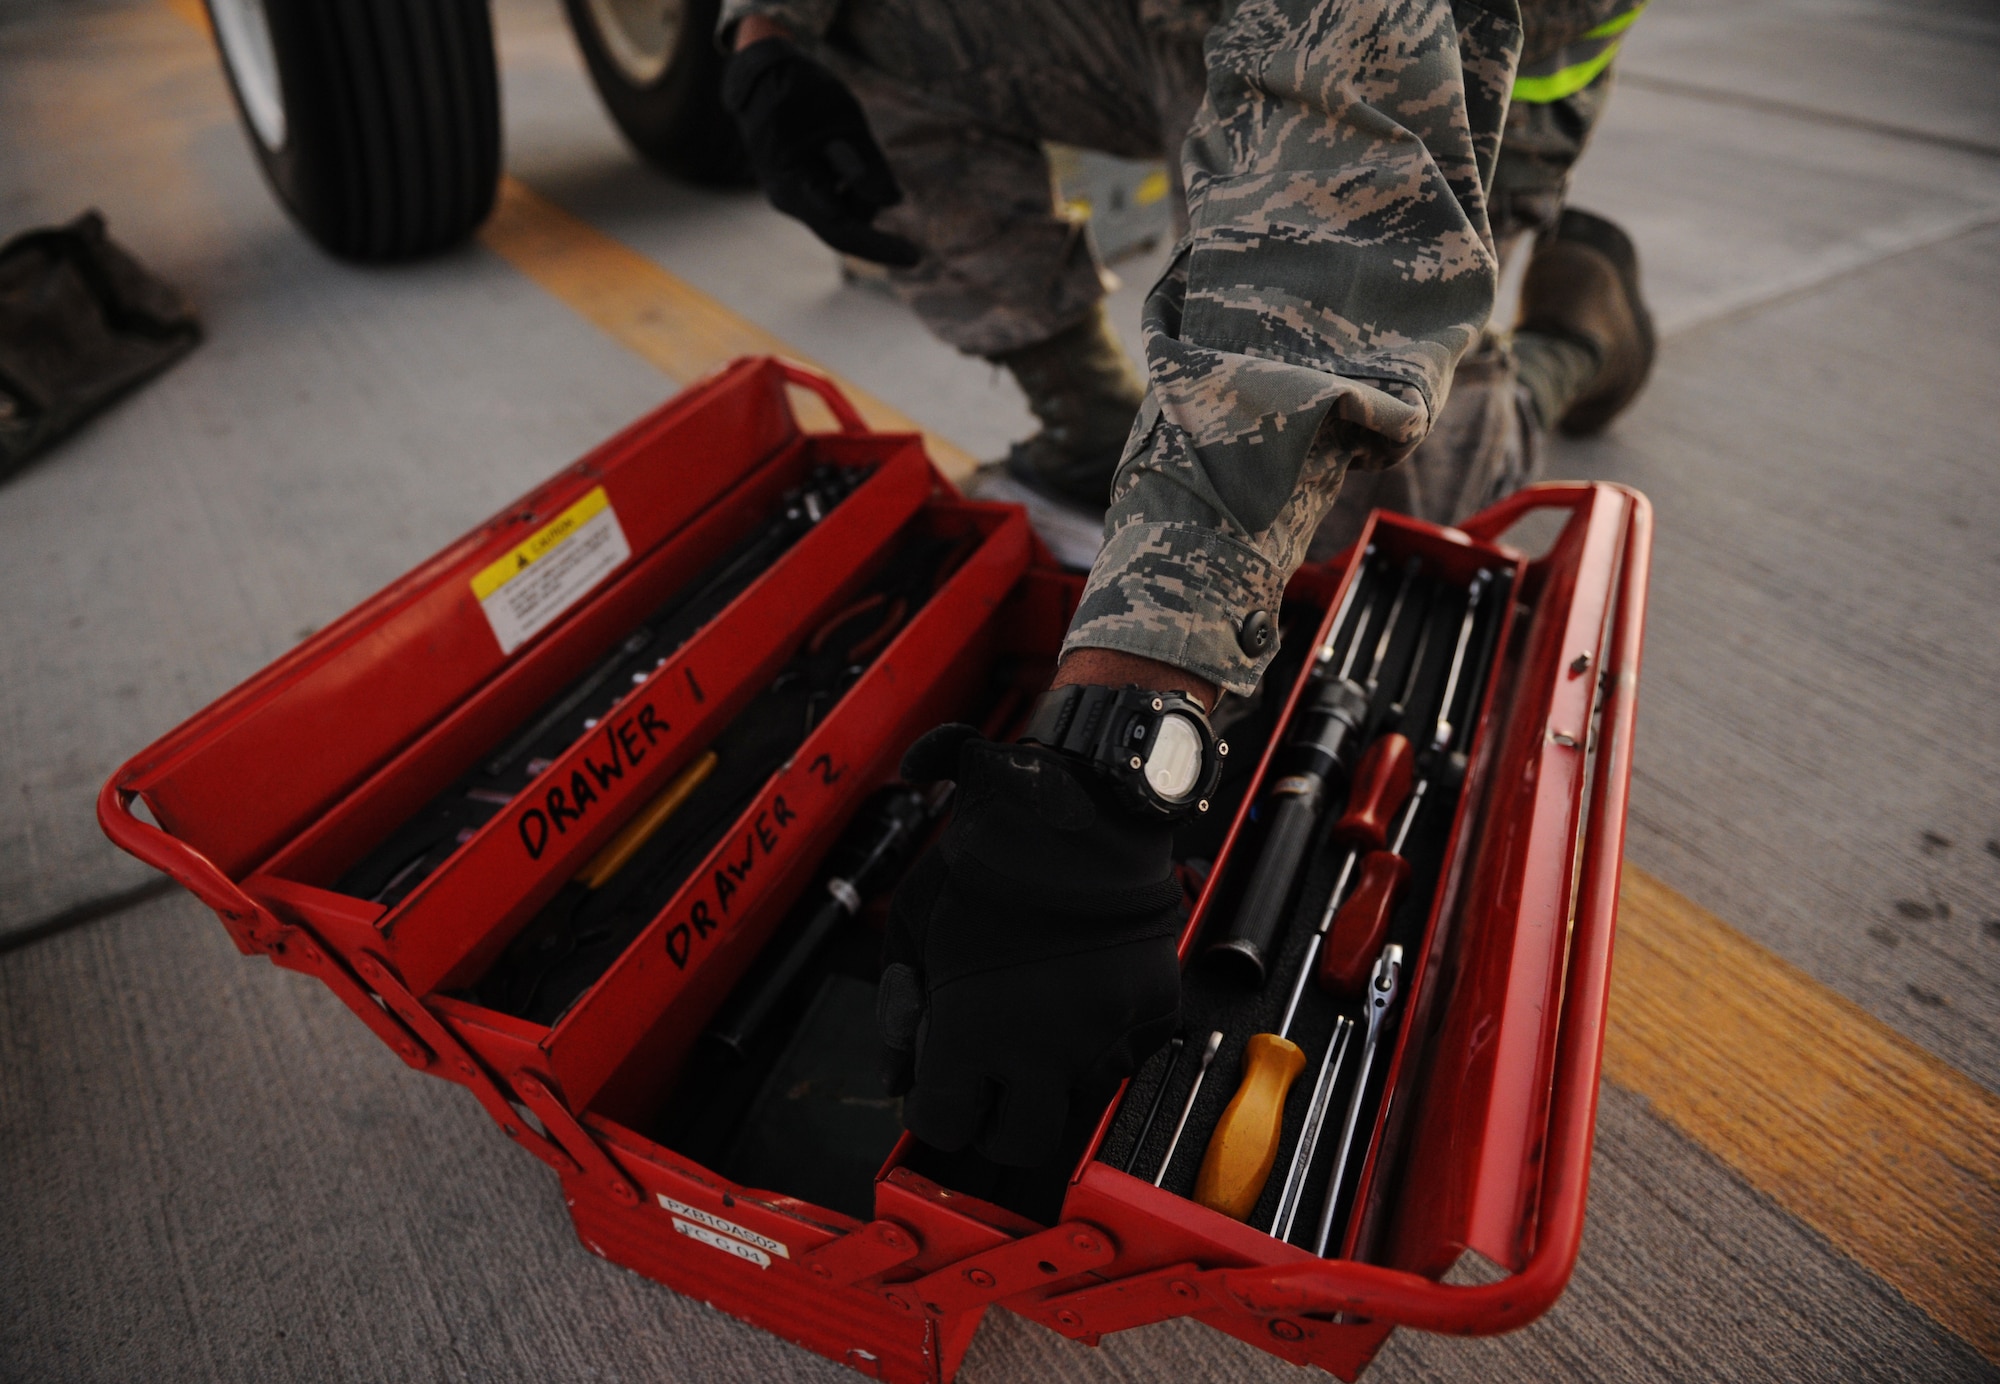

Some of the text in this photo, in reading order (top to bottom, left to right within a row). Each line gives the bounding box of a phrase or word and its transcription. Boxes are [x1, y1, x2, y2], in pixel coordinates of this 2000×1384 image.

[518, 667, 706, 861] DRAWER 1
[665, 752, 844, 970] DRAWER 2
